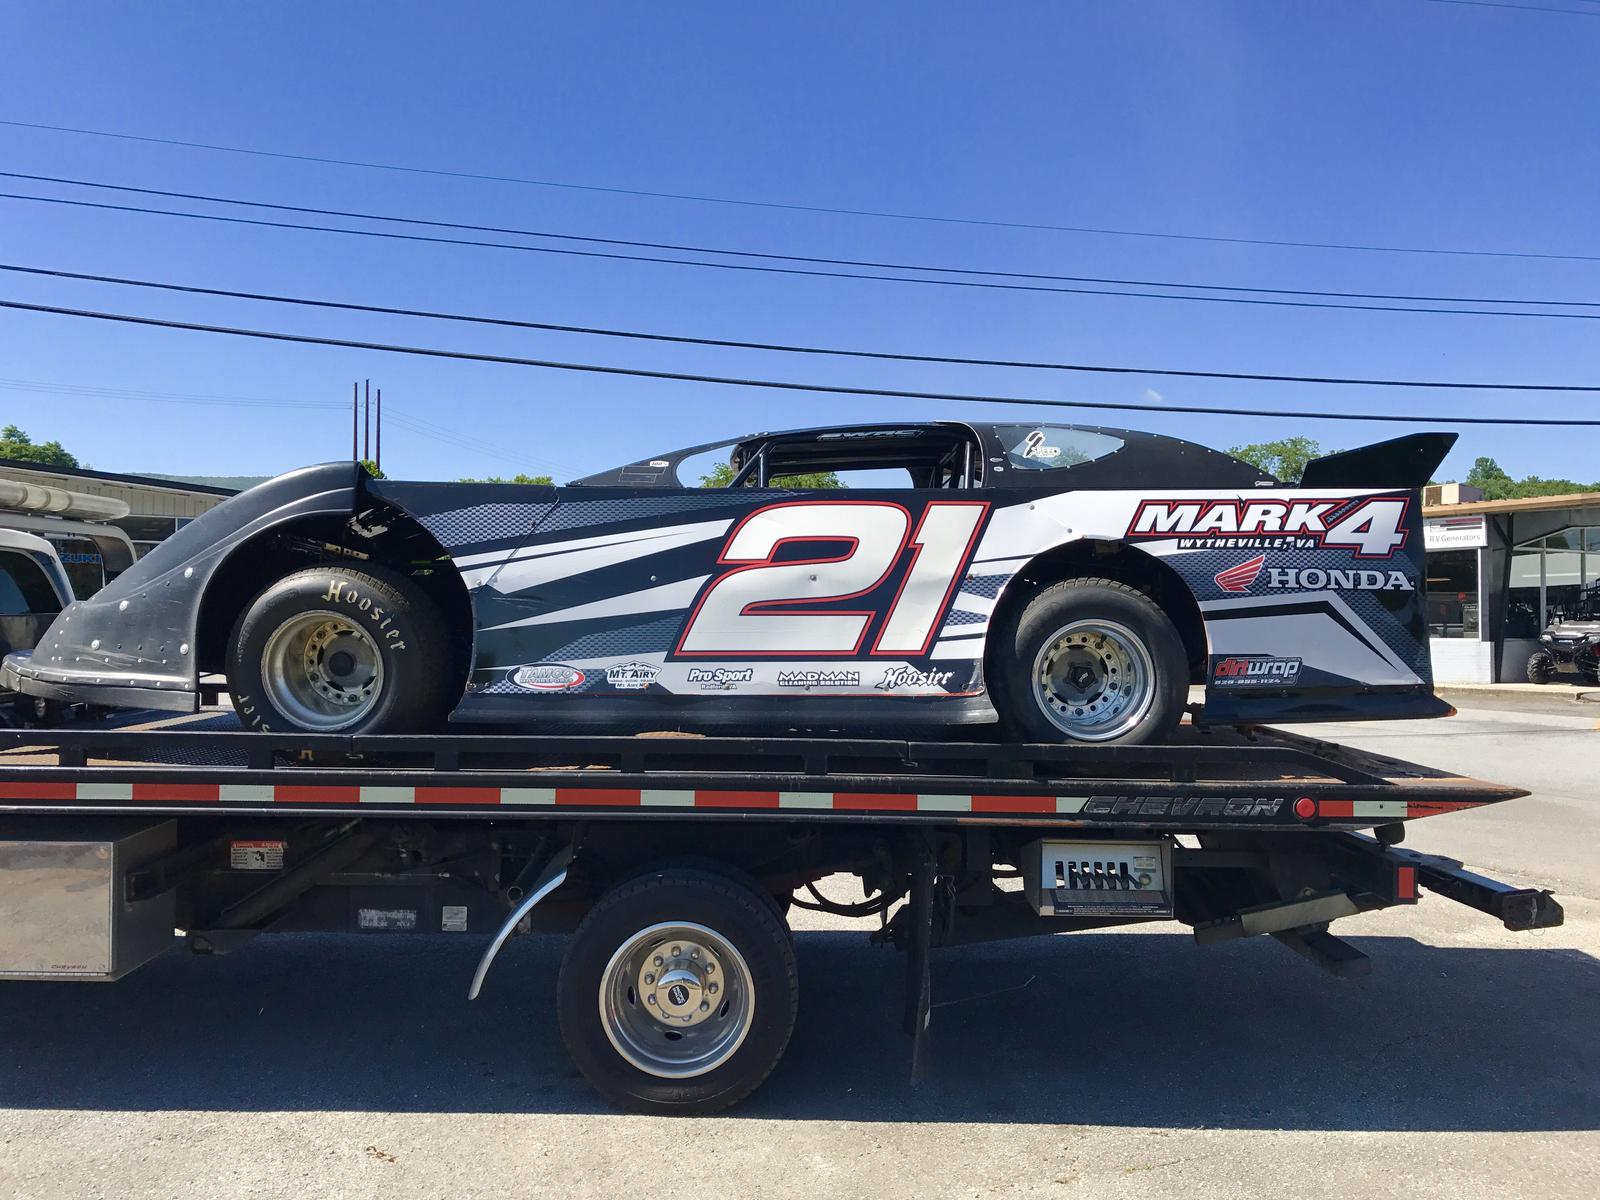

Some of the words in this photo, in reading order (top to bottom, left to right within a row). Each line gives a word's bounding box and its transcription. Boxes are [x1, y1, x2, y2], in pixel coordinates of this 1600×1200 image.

[1131, 499, 1343, 535] MARK
[1321, 498, 1408, 557] 4
[1296, 539, 1315, 549] VA
[1440, 534, 1481, 542] Generators
[60, 553, 100, 564] ZUKI
[674, 501, 991, 656] 21
[1267, 568, 1414, 591] HONDA
[321, 580, 406, 649] Hoosier
[777, 671, 860, 681] MADMAN
[875, 666, 954, 689] Hoosier
[1215, 659, 1300, 678] dirtwrap
[1084, 796, 1284, 816] CHEVRON
